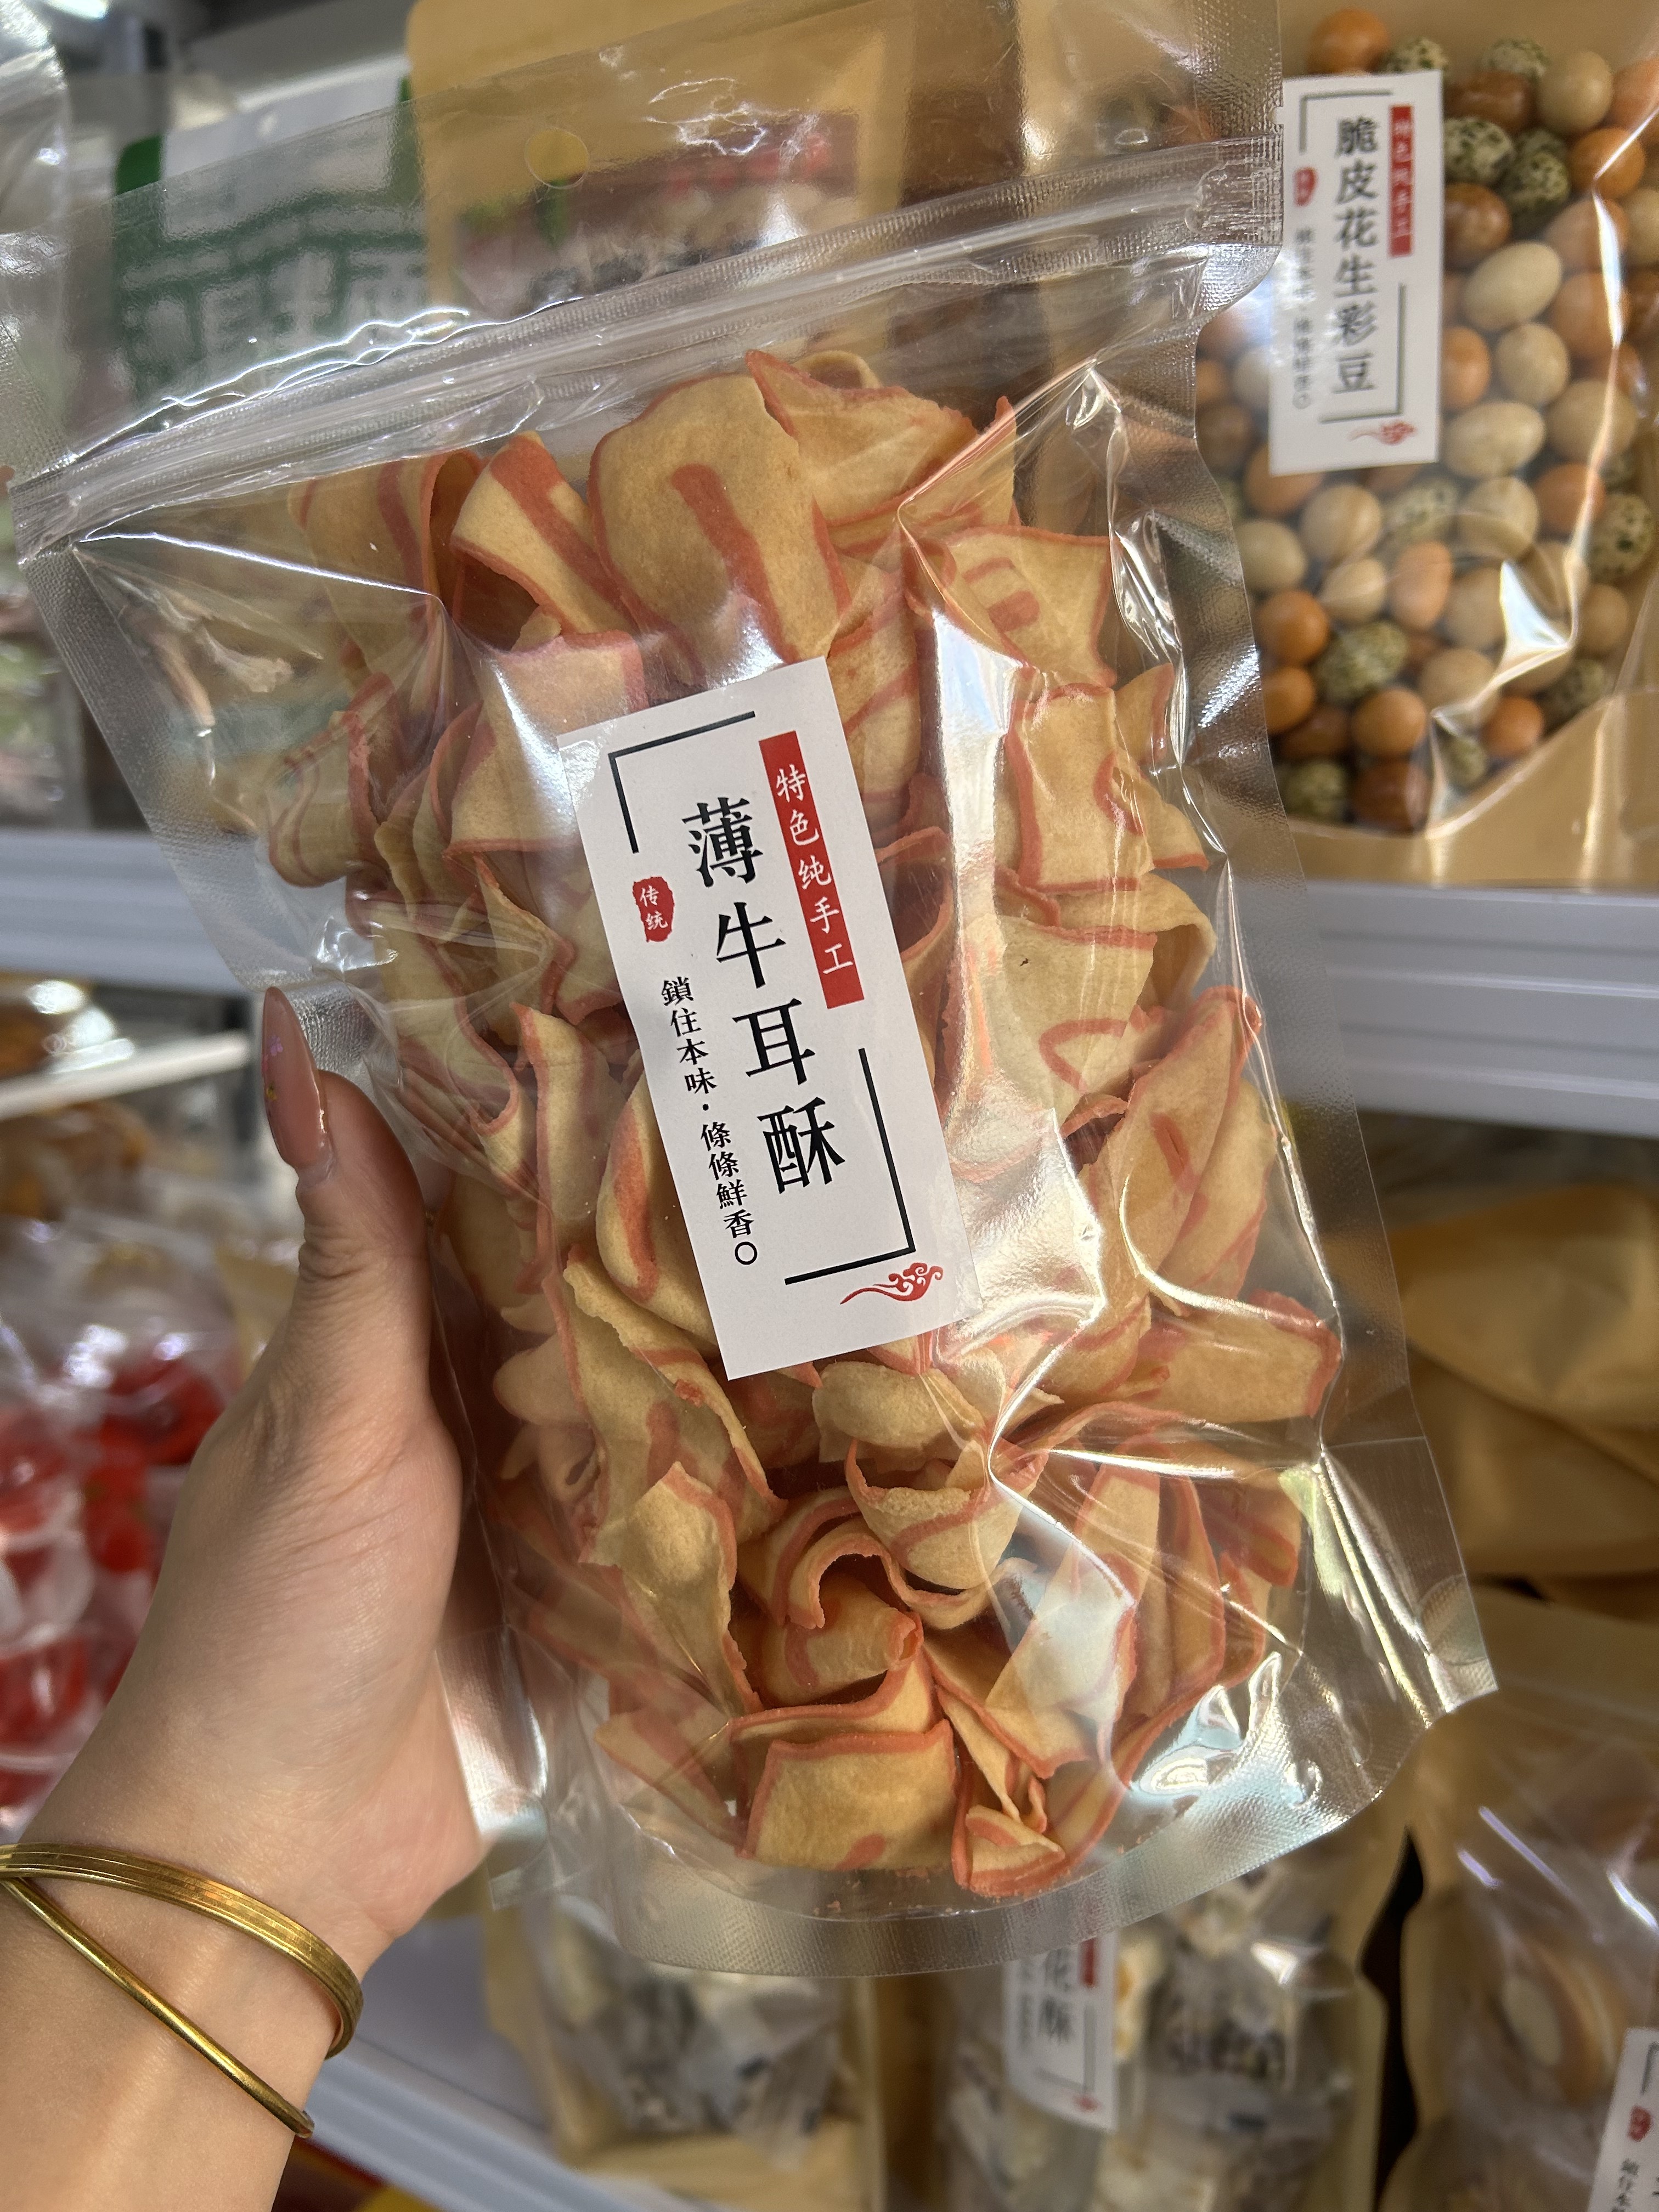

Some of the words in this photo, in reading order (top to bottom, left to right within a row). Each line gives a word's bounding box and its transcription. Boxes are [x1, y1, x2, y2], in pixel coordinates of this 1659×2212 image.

[1332, 115, 1380, 394] 脆皮花生彩豆
[639, 885, 668, 931] 传统
[776, 764, 854, 974] 特色纯手工
[682, 797, 846, 1195] 薄牛耳酥
